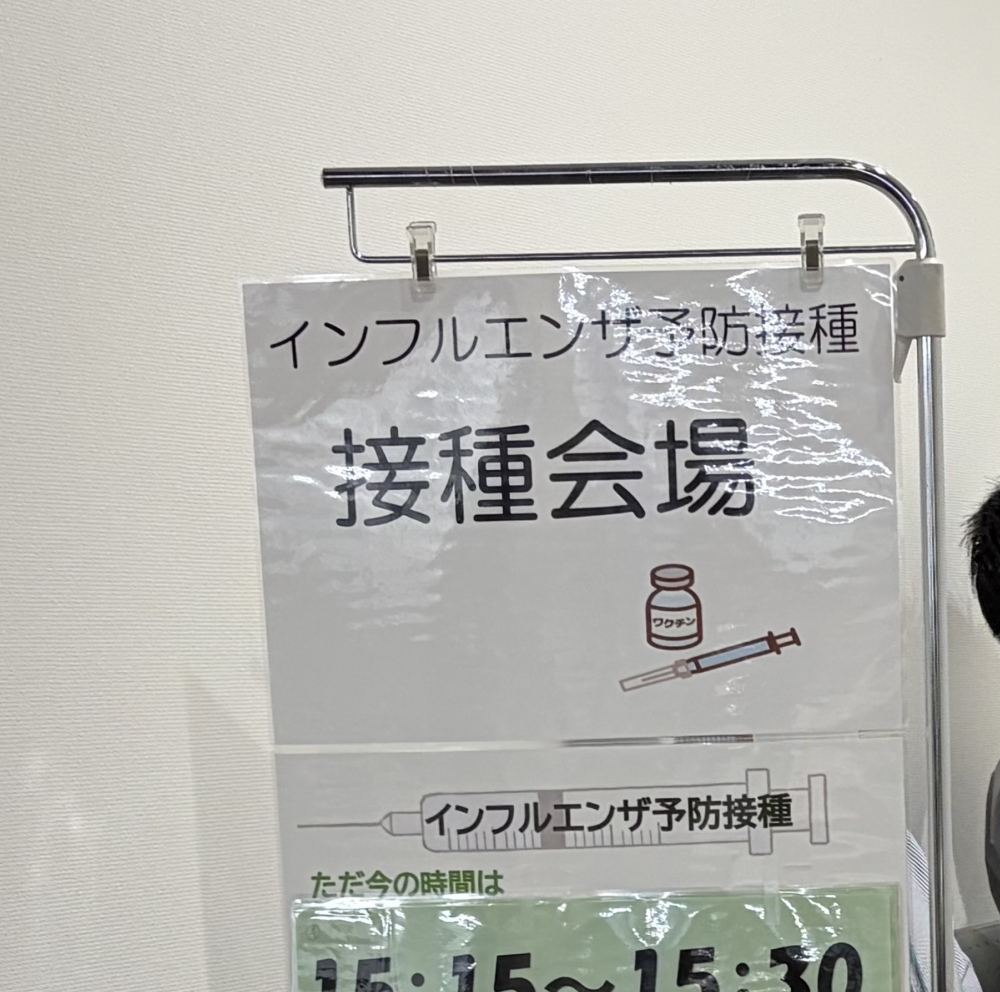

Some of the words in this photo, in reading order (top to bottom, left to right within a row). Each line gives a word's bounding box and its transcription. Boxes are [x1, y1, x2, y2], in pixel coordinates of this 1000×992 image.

[269, 302, 860, 369] インフルエンザ予防接種
[332, 419, 756, 527] 接種会場
[652, 617, 696, 628] ワクチン
[424, 792, 794, 836] インフルエンザ予防接種
[311, 870, 505, 898] ただ今の時間は
